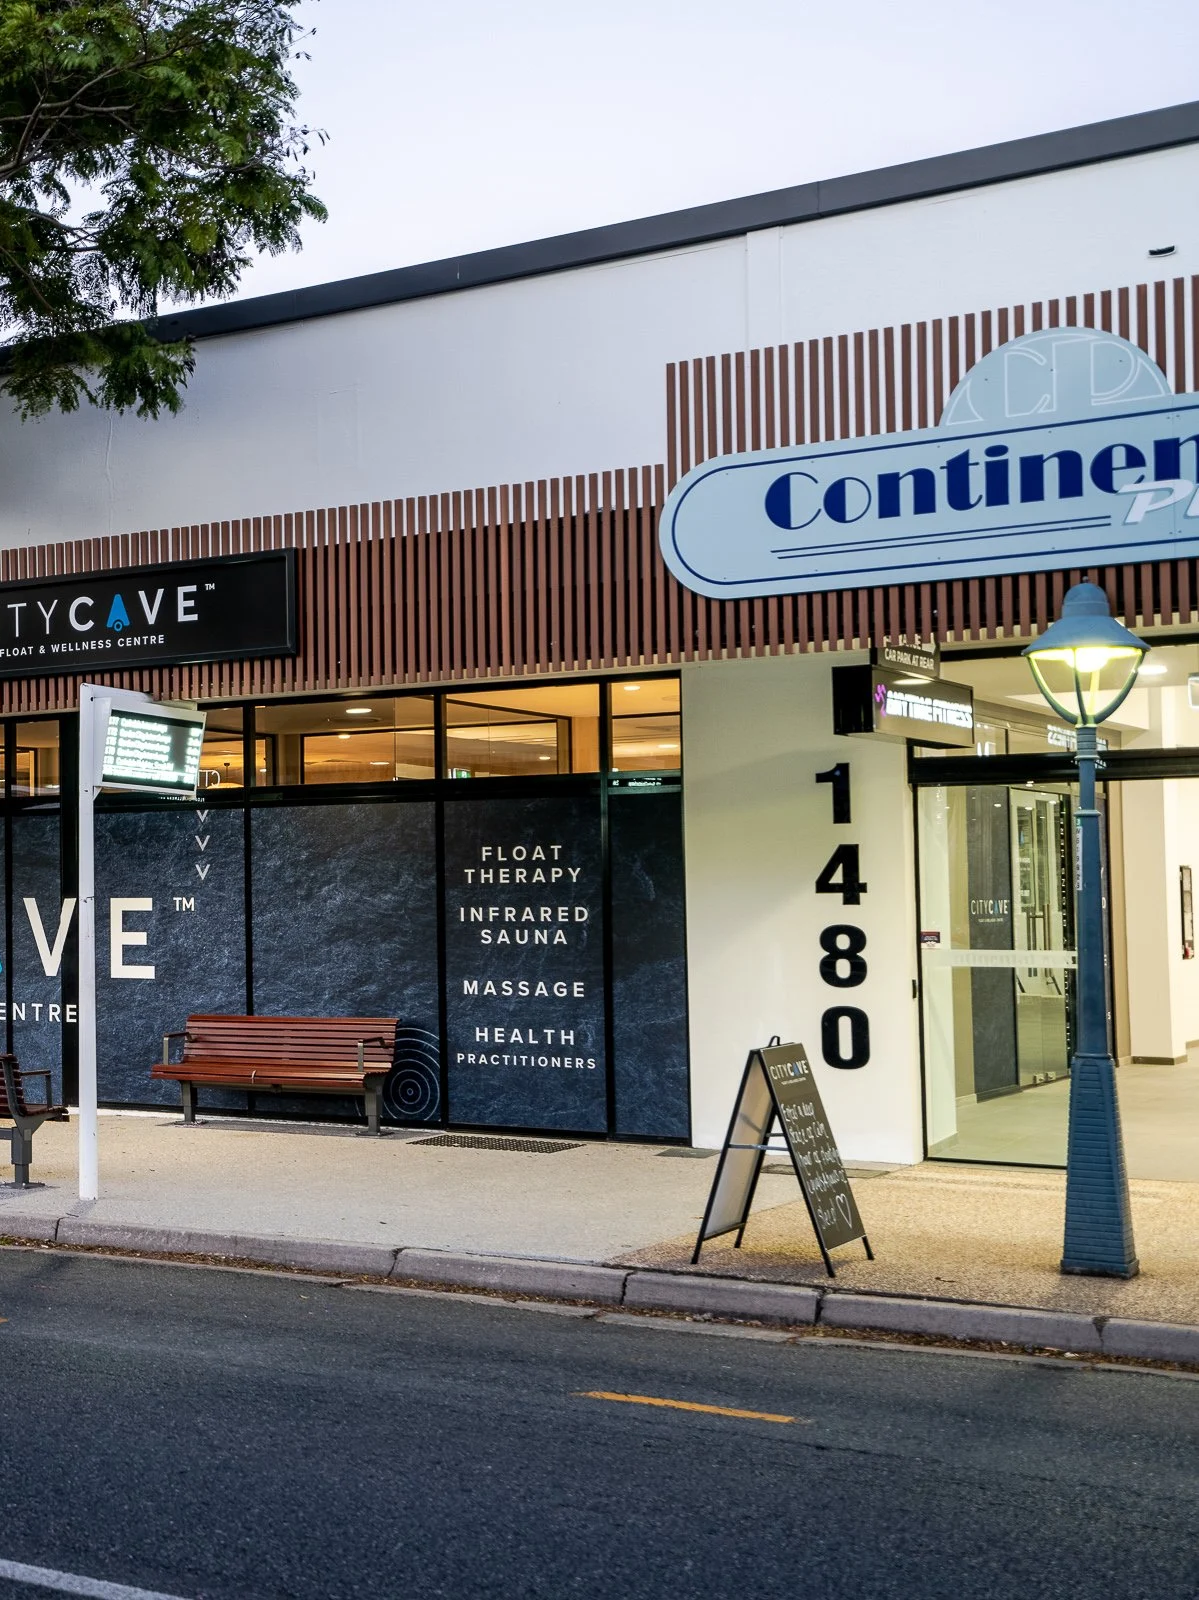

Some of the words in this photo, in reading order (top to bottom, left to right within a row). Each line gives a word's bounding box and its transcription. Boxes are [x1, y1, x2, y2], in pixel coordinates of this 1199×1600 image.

[0, 646, 34, 658] FLOAT
[39, 645, 46, 654] &
[51, 640, 112, 653] WELLNESS
[117, 635, 165, 648] CENTRE
[884, 648, 896, 660] CAR
[896, 651, 912, 665] PARK
[911, 655, 920, 666] AT
[920, 656, 935, 670] REAR
[481, 845, 562, 861] FLOAT
[464, 867, 581, 884] THERAPY
[459, 906, 589, 922] INFRARED
[814, 762, 871, 1070] 1480
[480, 929, 568, 945] SAUNA
[463, 980, 585, 998] MASSAGE
[475, 1027, 575, 1045] HEALTH
[456, 1053, 597, 1070] PRACTITIONERS
